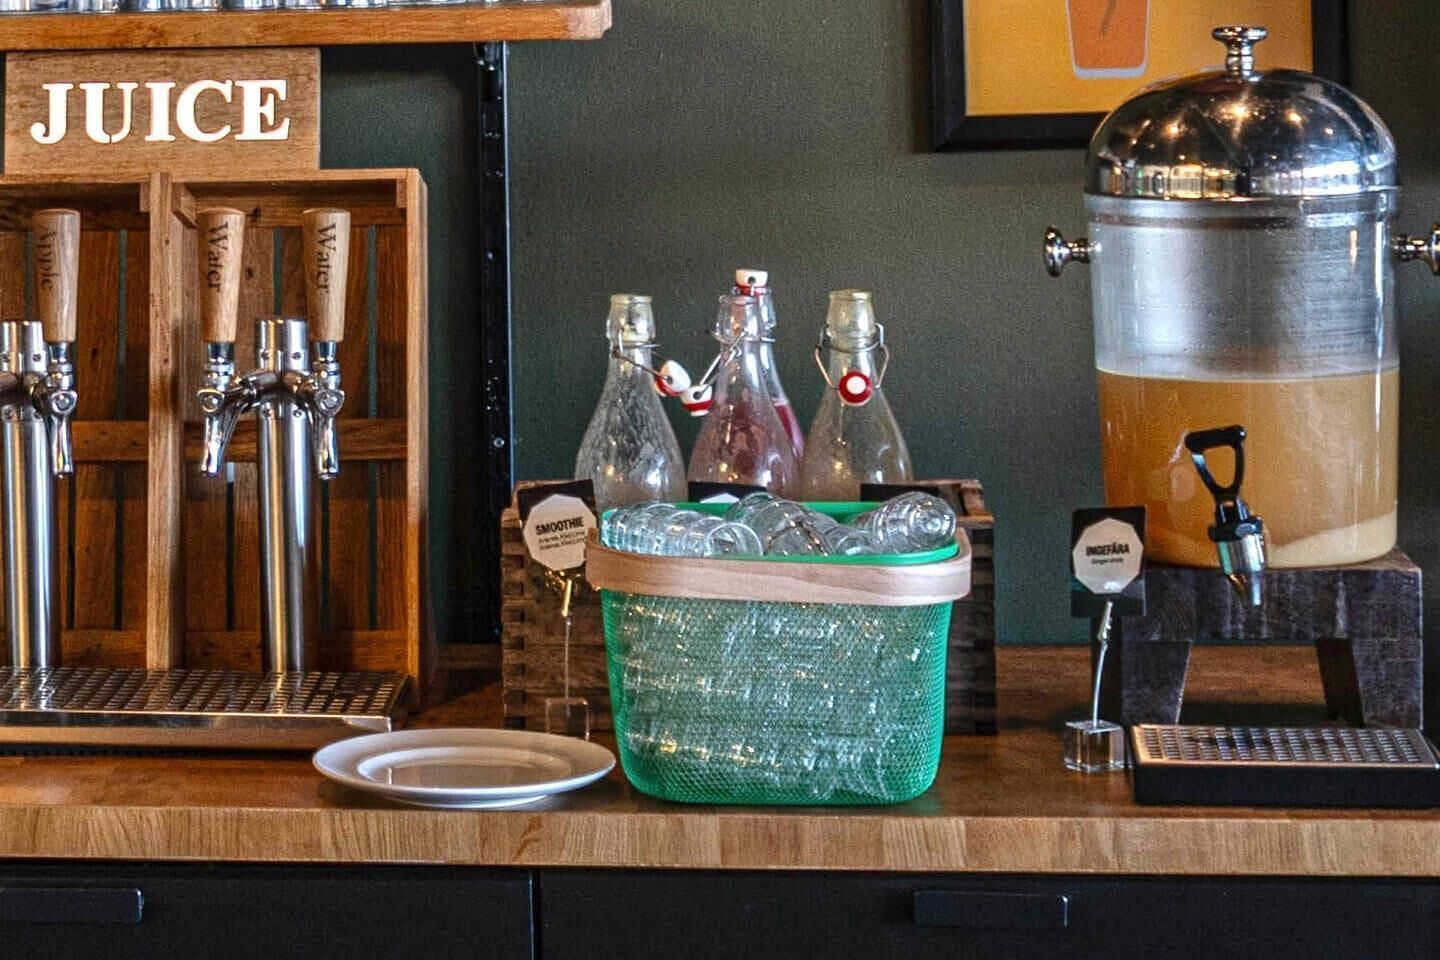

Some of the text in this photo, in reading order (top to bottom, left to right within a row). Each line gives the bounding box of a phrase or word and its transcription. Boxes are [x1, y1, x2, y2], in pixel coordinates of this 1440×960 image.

[30, 79, 290, 145] JUICE
[36, 226, 58, 292] Apple
[206, 222, 230, 294] Water
[316, 222, 338, 295] Water
[535, 516, 585, 535] SMOOTHIE
